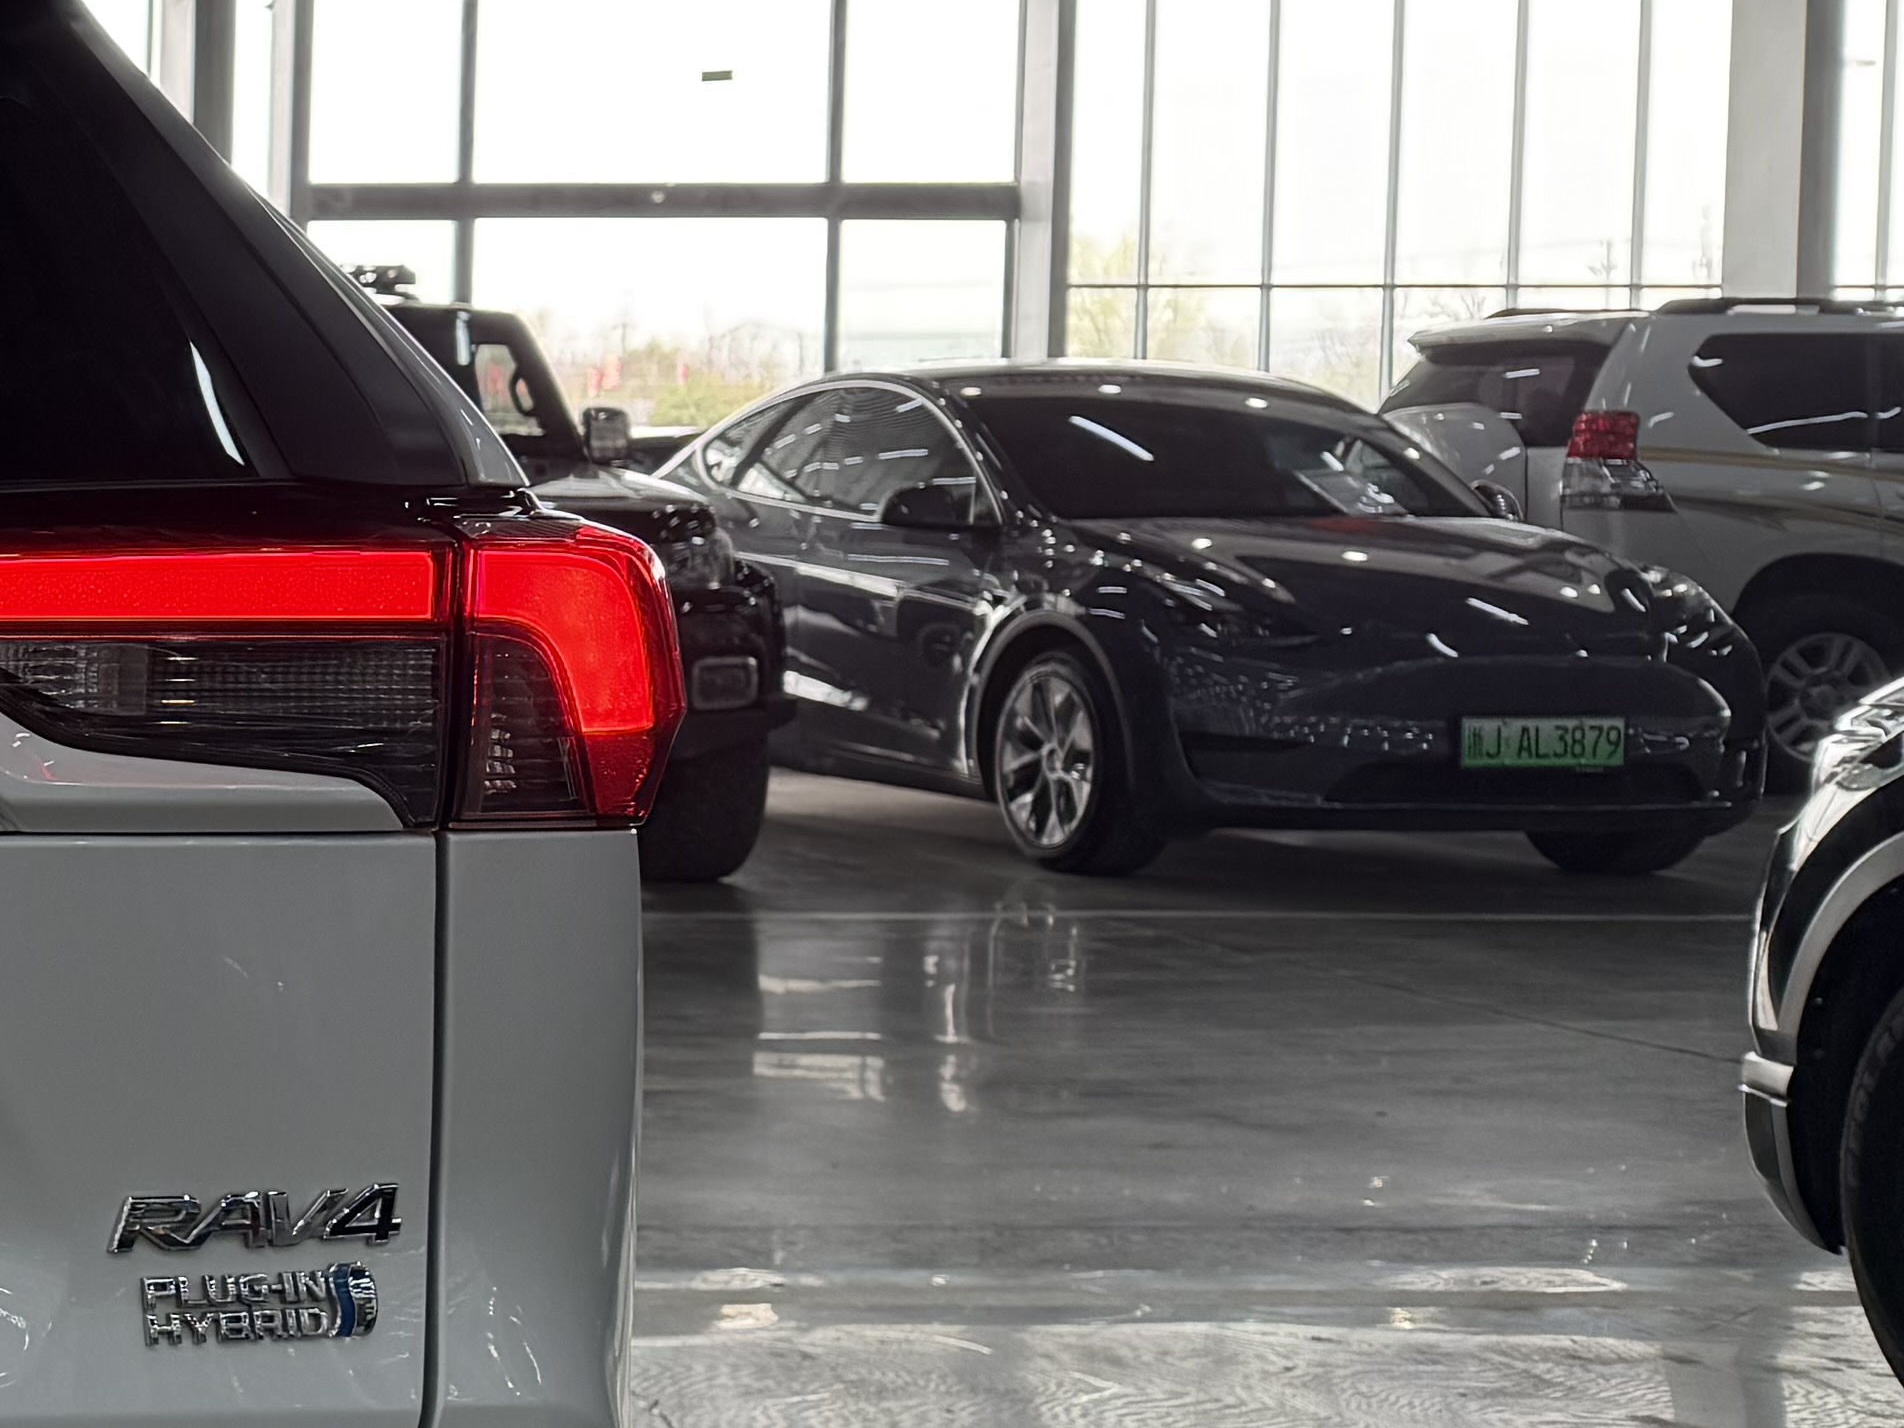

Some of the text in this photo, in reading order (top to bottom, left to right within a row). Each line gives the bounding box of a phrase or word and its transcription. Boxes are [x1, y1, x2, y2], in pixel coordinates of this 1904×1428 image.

[1517, 724, 1622, 760] AL3879
[107, 1182, 403, 1253] RAV4
[141, 1271, 328, 1309] PLUG-IN
[142, 1307, 329, 1347] HYBRID
